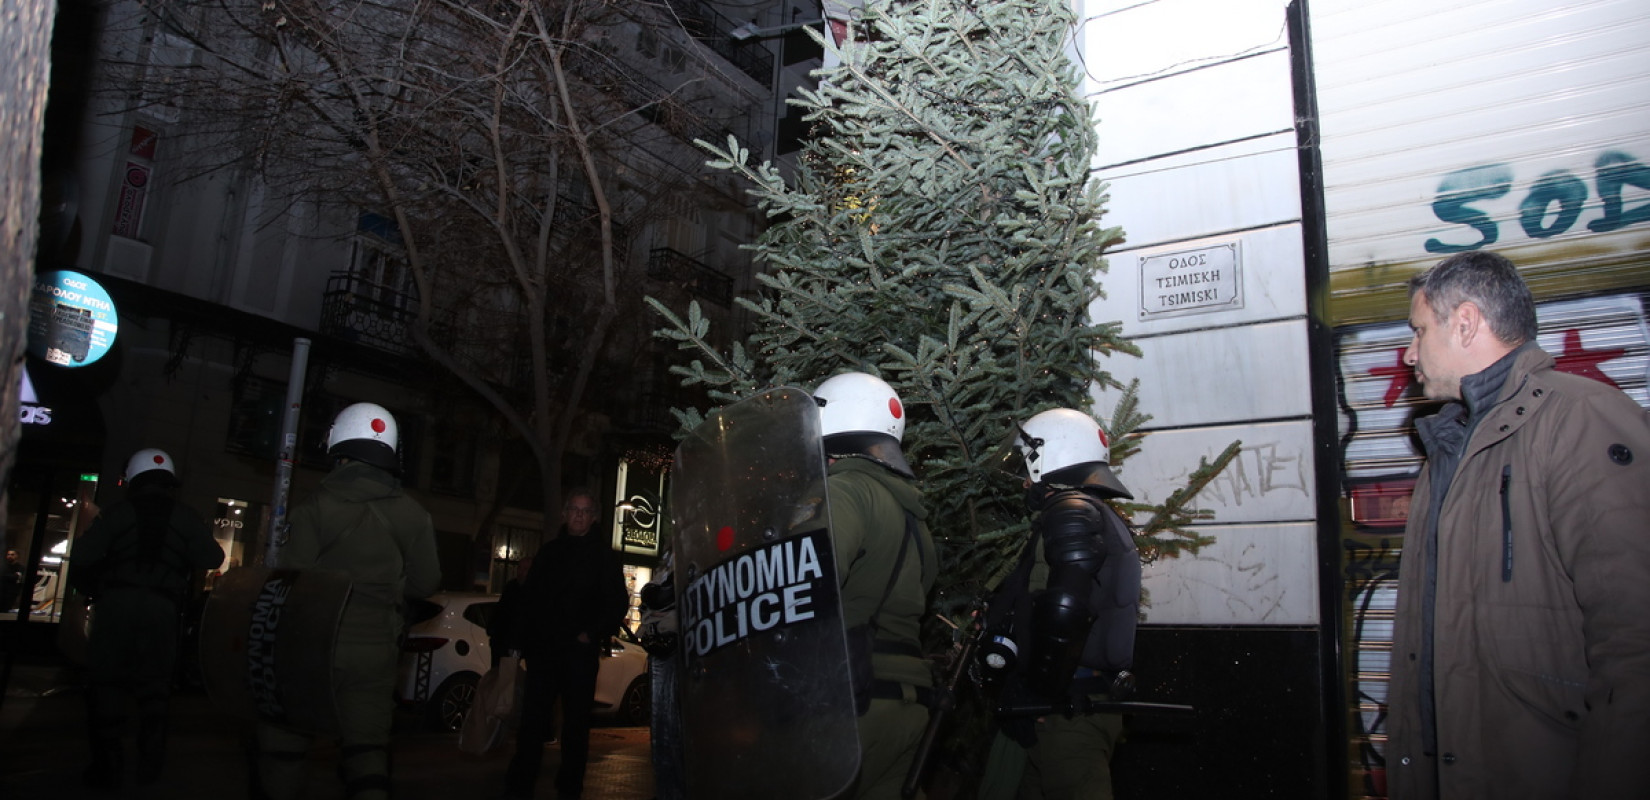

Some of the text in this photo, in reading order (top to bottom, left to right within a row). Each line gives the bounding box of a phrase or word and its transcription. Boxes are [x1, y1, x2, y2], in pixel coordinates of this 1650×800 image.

[1168, 254, 1206, 269] ΟΔΟΣ
[1156, 269, 1220, 289] ΤΣΙΜΙΣΚΗ
[1158, 288, 1218, 306] TSIMISKI
[684, 582, 815, 668] POLICE
